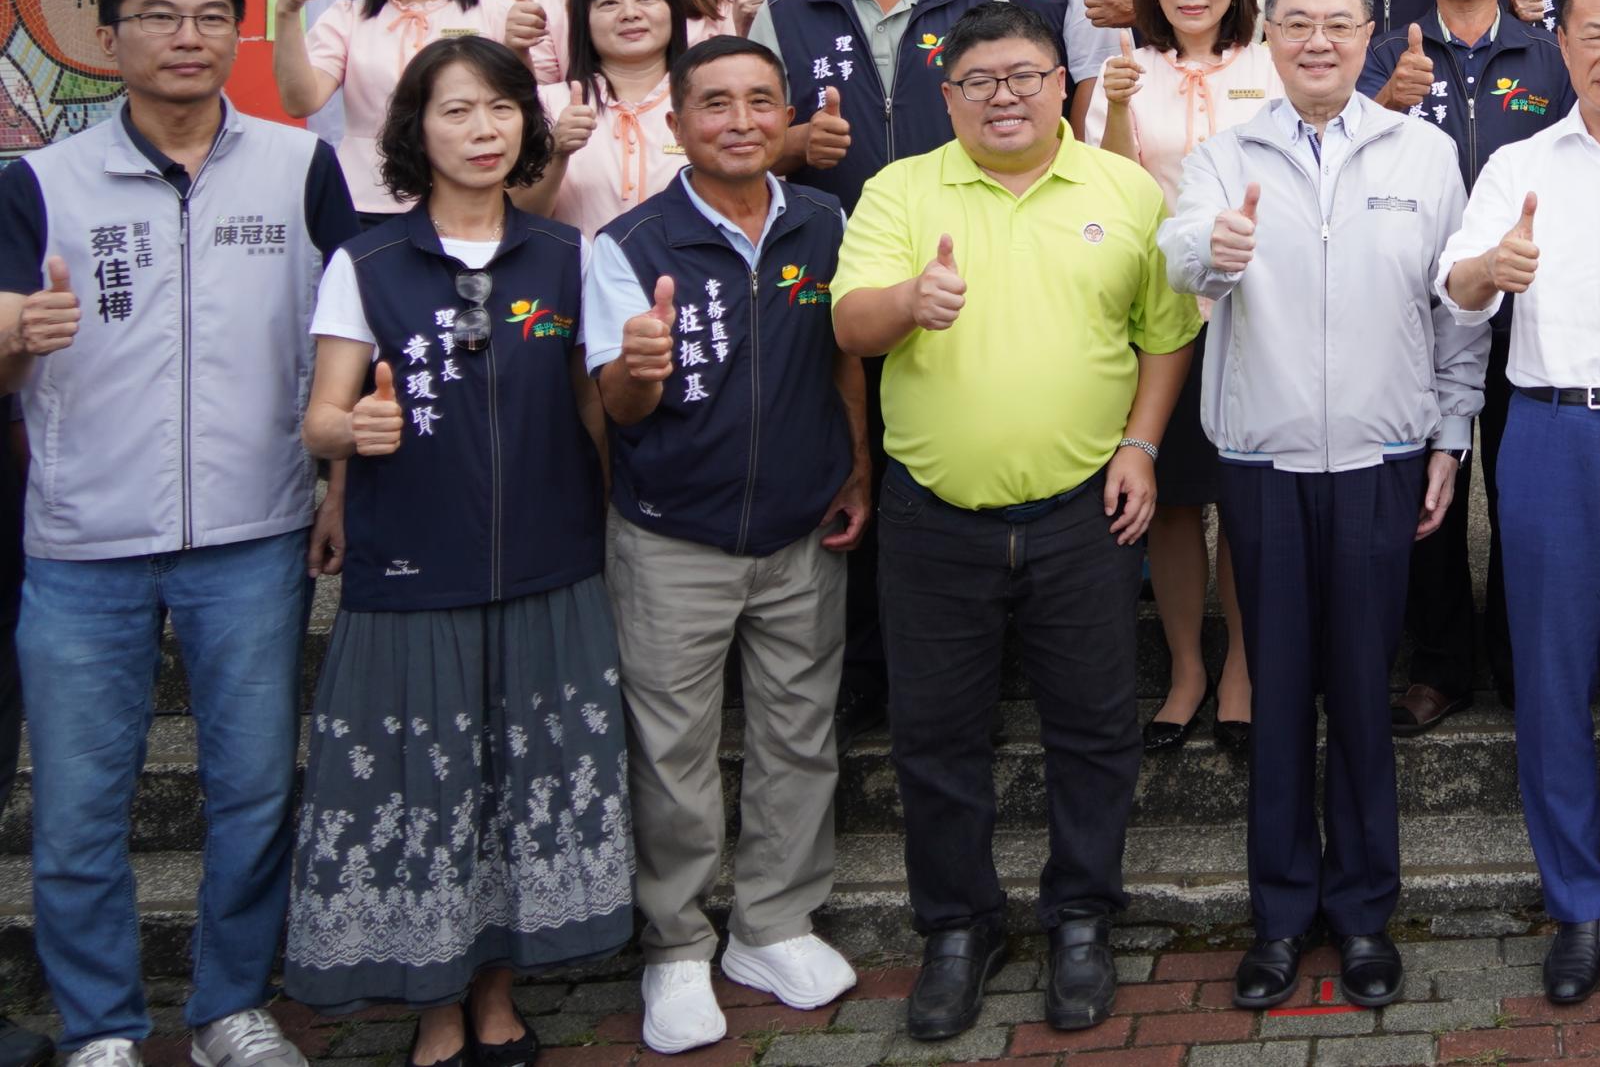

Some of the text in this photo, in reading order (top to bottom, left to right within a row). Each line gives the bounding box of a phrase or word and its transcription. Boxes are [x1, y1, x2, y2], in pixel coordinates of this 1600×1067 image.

[836, 35, 853, 81] 理事
[1431, 81, 1448, 124] 理事
[132, 221, 153, 268] 副主任
[214, 224, 286, 246] 陳冠廷
[90, 225, 133, 323] 蔡佳樺
[434, 308, 463, 382] 理事長
[705, 279, 729, 363] 常務監事
[679, 304, 710, 402] 莊振基
